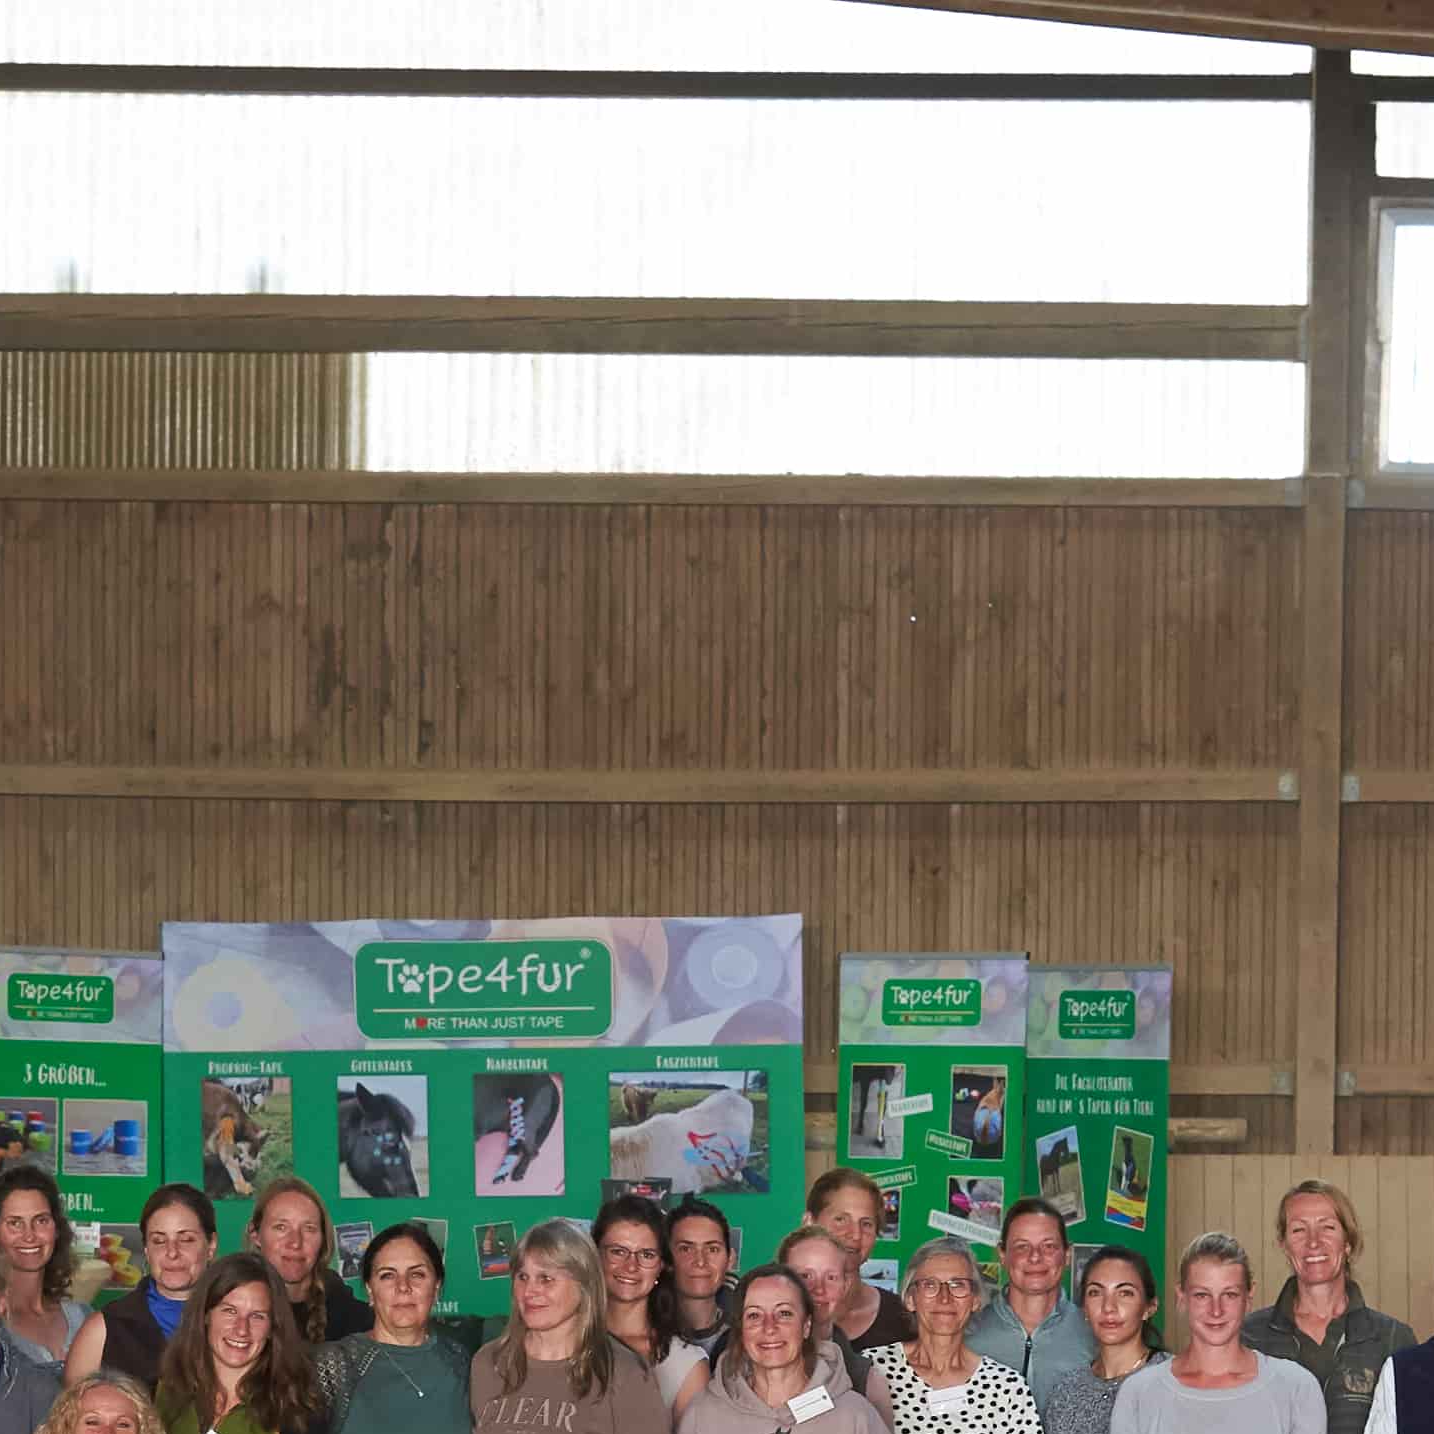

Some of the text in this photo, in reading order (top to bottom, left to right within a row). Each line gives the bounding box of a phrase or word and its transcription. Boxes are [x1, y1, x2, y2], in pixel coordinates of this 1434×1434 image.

[404, 1015, 565, 1030] MORE THAN JUST TAPE
